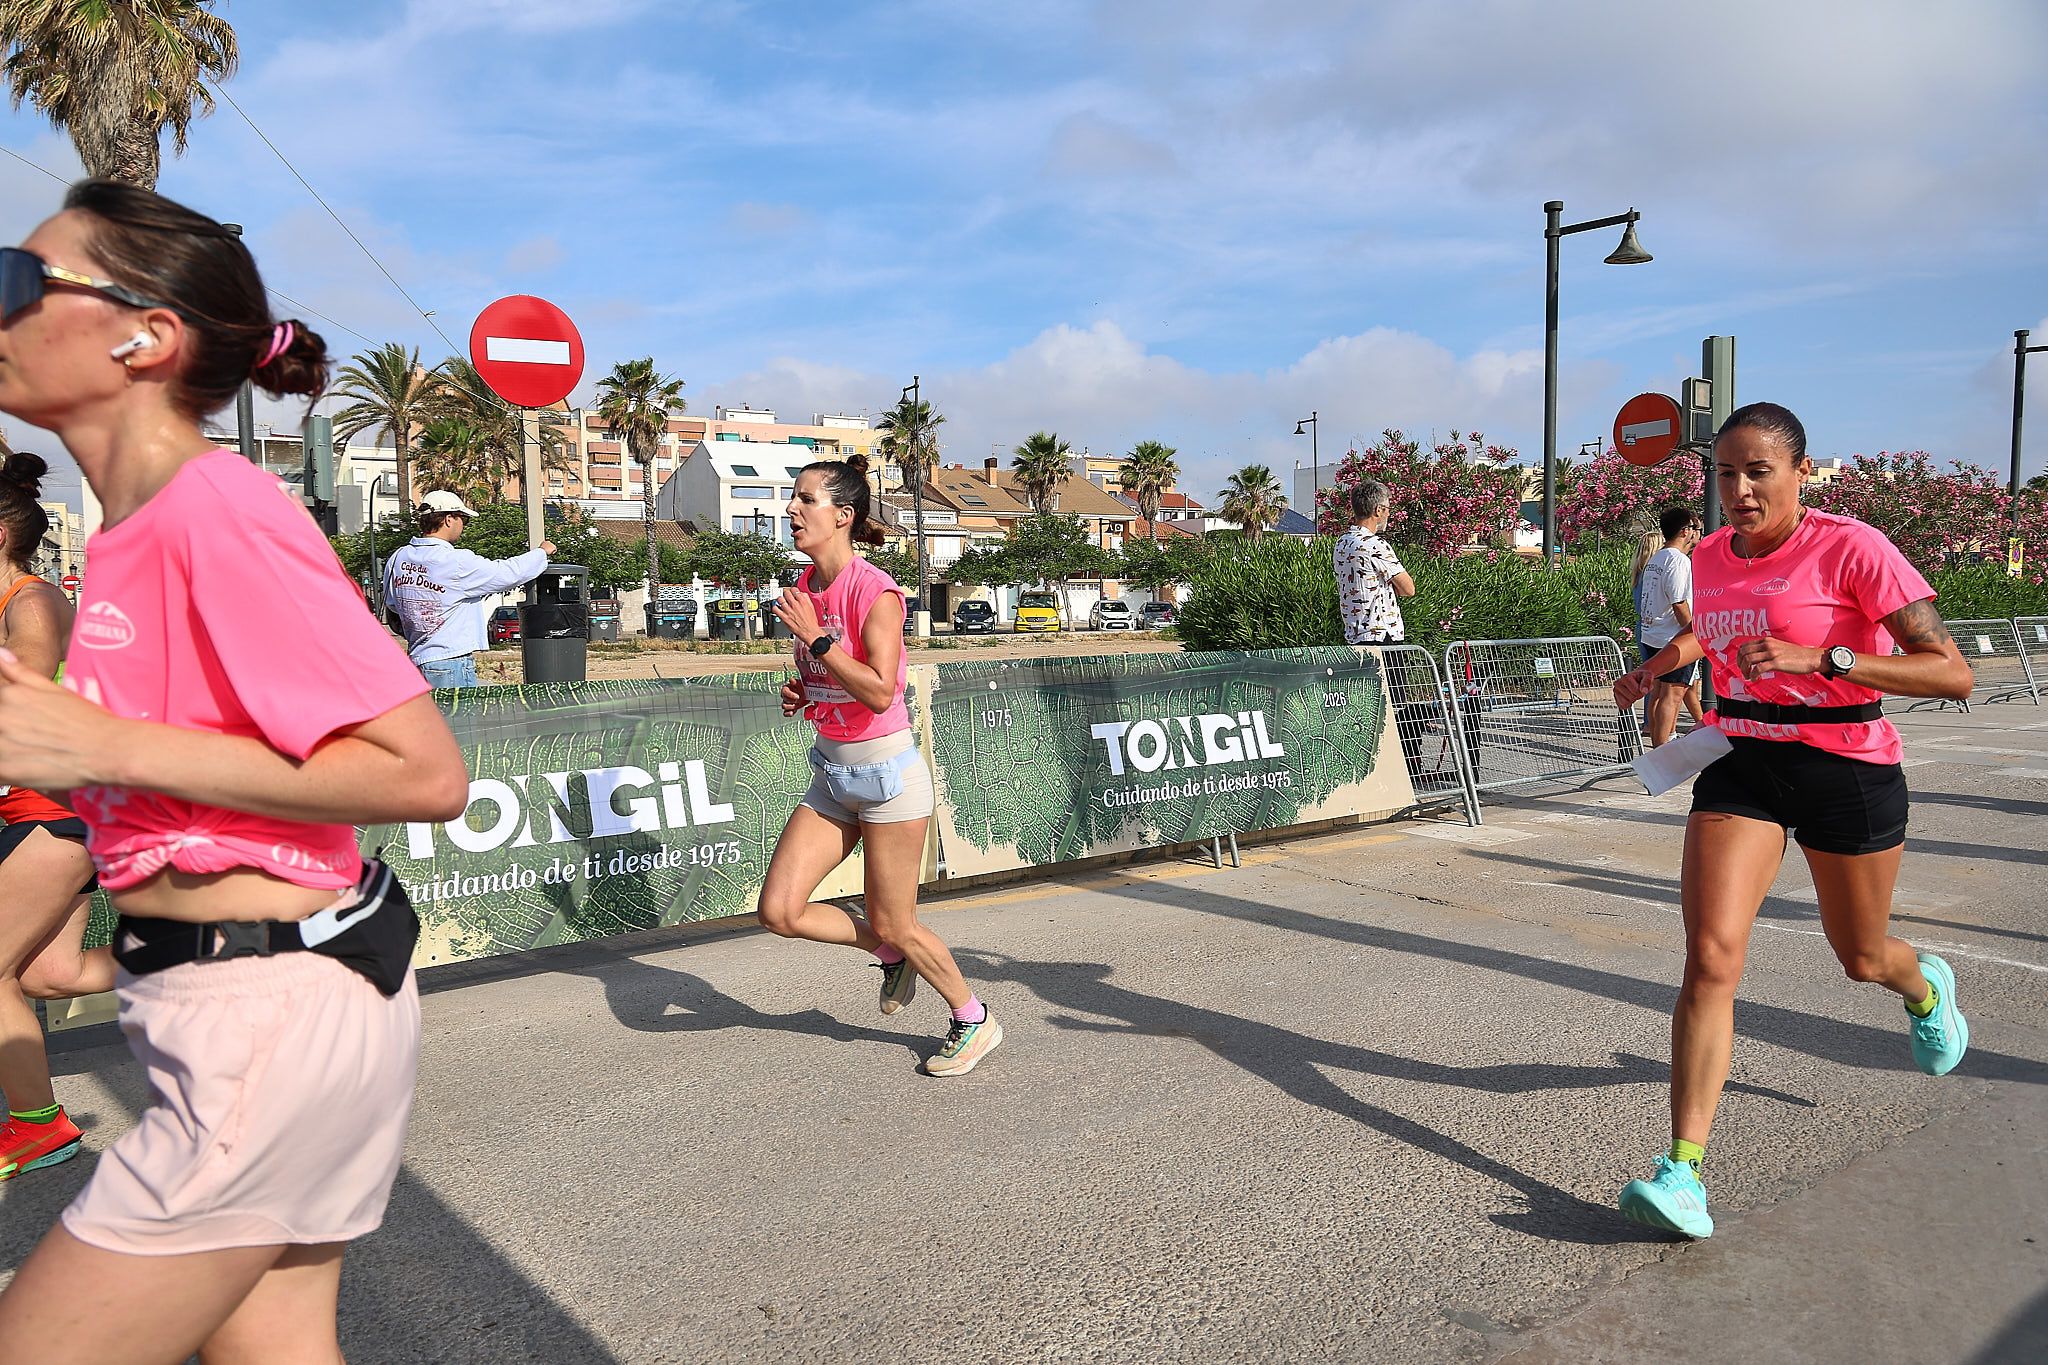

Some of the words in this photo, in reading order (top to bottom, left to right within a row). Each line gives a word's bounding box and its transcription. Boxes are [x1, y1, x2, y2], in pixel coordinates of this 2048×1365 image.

[1323, 692, 1347, 707] 2026
[981, 709, 1012, 728] 1975
[1103, 781, 1180, 807] Cuidando
[1183, 777, 1201, 797] de
[1203, 776, 1216, 795] ti
[1219, 773, 1259, 792] desde
[1262, 770, 1291, 789] 1975
[544, 858, 577, 885] de
[583, 852, 603, 880] ti
[609, 844, 682, 876] desde
[689, 841, 741, 868] 1975
